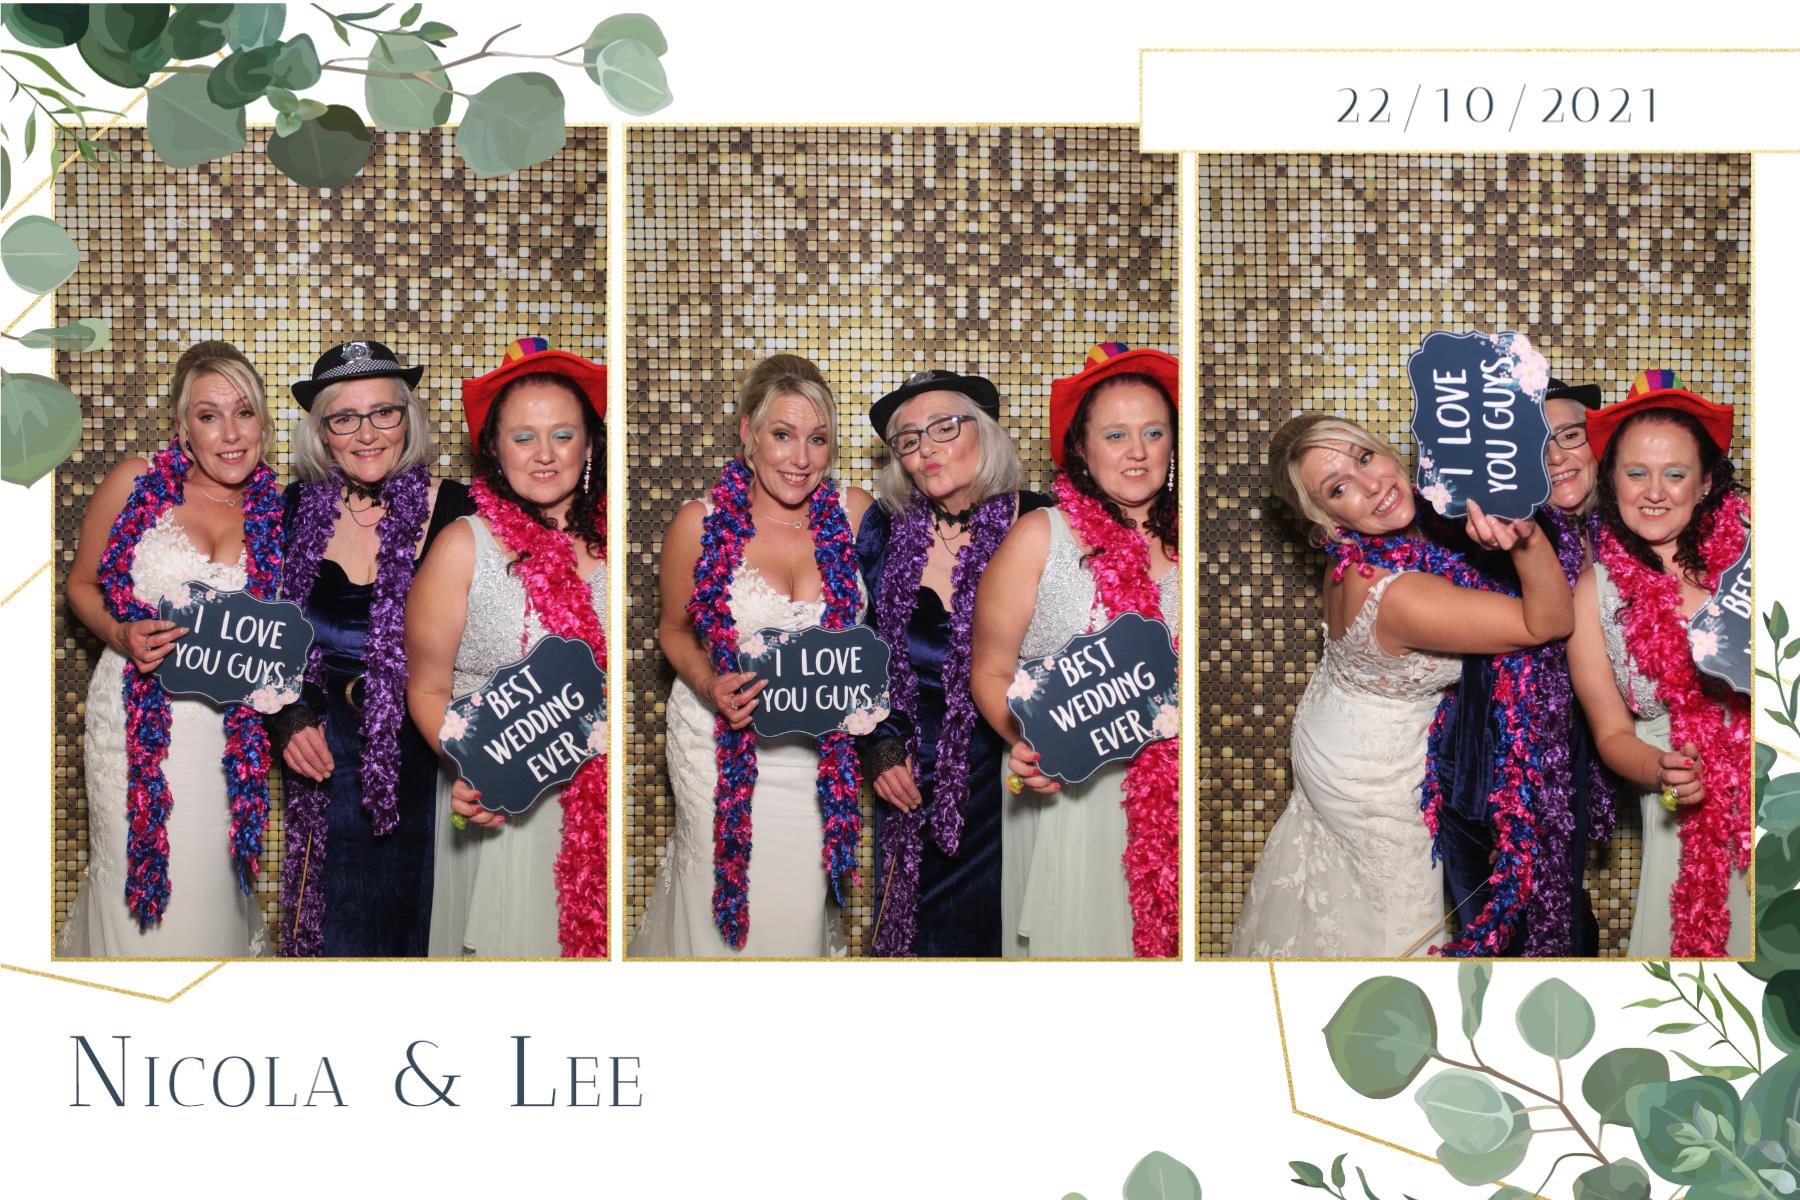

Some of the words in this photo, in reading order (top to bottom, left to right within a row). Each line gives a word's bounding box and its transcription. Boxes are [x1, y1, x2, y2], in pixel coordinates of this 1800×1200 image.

[1432, 368, 1472, 445] LOVE
[1479, 356, 1516, 430] GUYS
[1439, 467, 1473, 476] I
[1485, 439, 1518, 493] YOU
[194, 604, 204, 634] I
[220, 610, 287, 650] LOVE
[175, 642, 222, 676] YOU
[227, 652, 286, 688] GUYS
[775, 648, 782, 677] I
[801, 646, 863, 677] LOVE
[1058, 637, 1116, 688] BEST
[485, 664, 543, 720] BEST
[762, 686, 808, 713] YOU
[815, 683, 873, 711] GUYS
[1048, 661, 1156, 732] WEDDING
[482, 682, 585, 765] WEDDING
[1090, 709, 1153, 757] EVER
[526, 731, 592, 783] EVER
